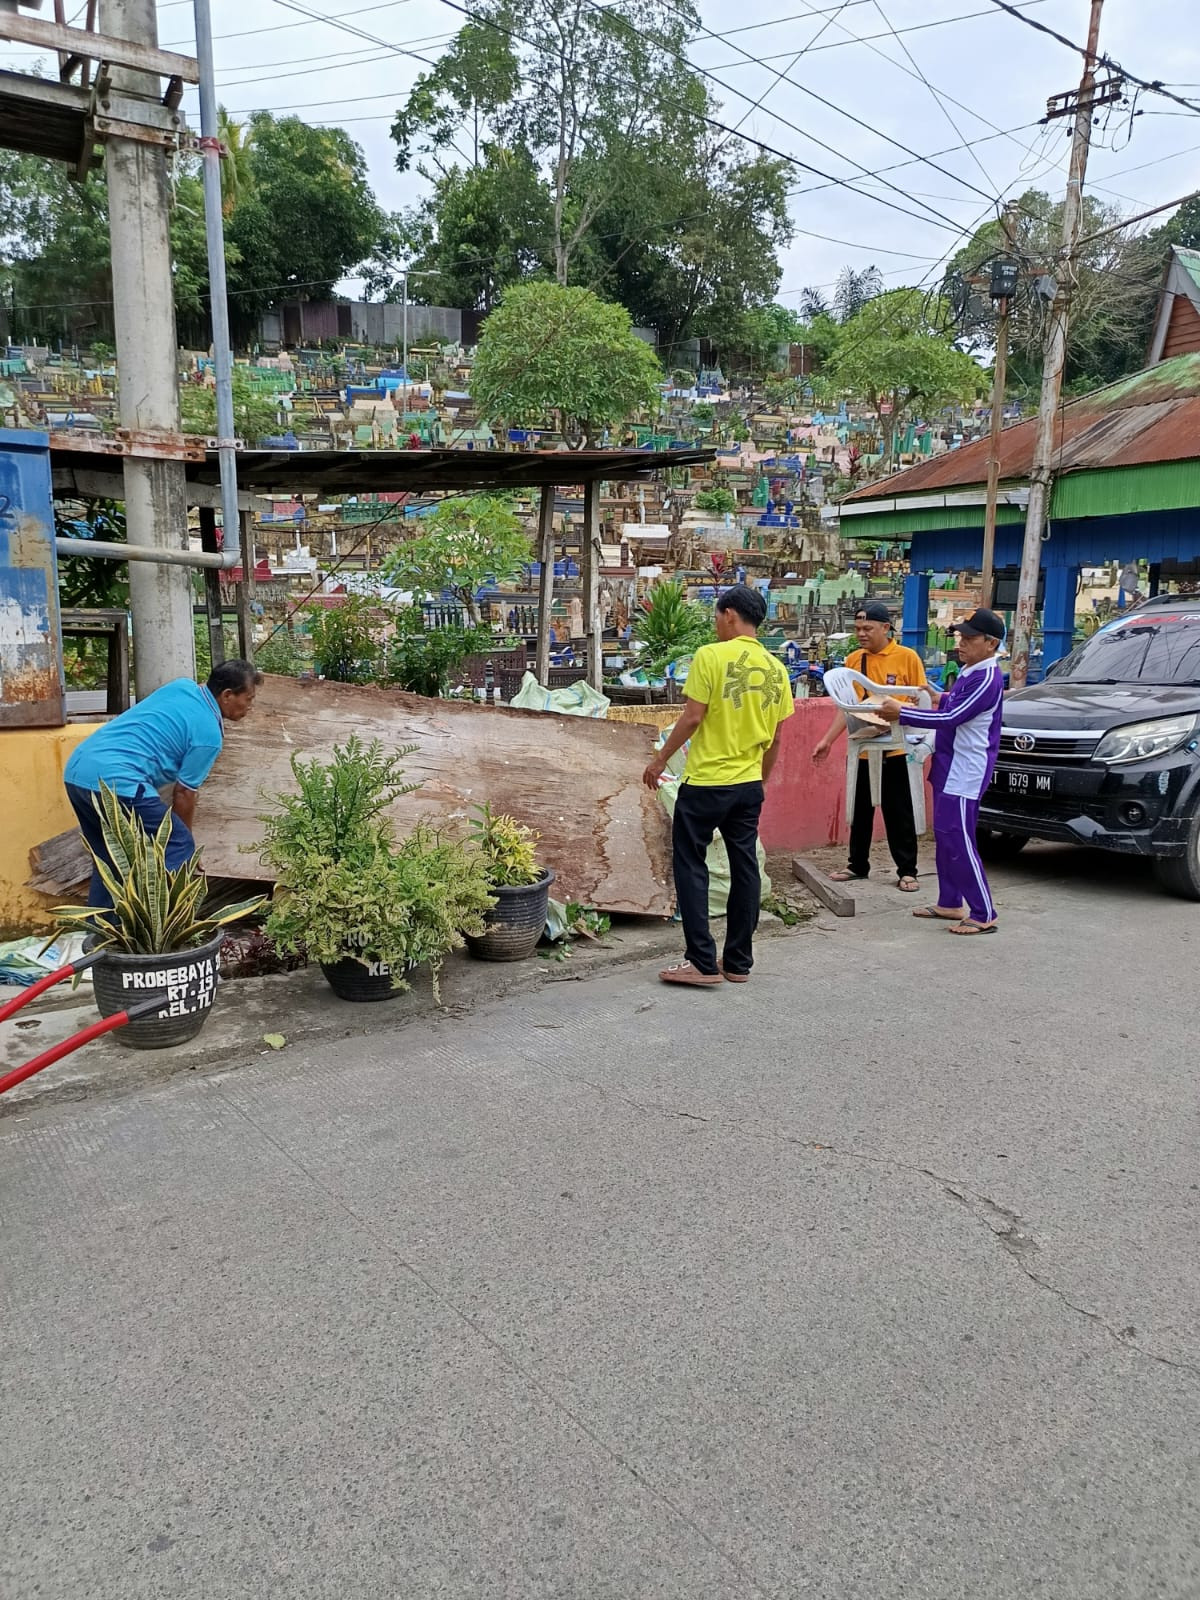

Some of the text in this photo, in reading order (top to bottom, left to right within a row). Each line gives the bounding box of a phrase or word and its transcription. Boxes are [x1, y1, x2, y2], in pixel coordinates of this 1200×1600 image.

[1009, 772, 1029, 788] 1679
[1036, 775, 1051, 790] MM
[122, 959, 213, 989] PROBEBAYA
